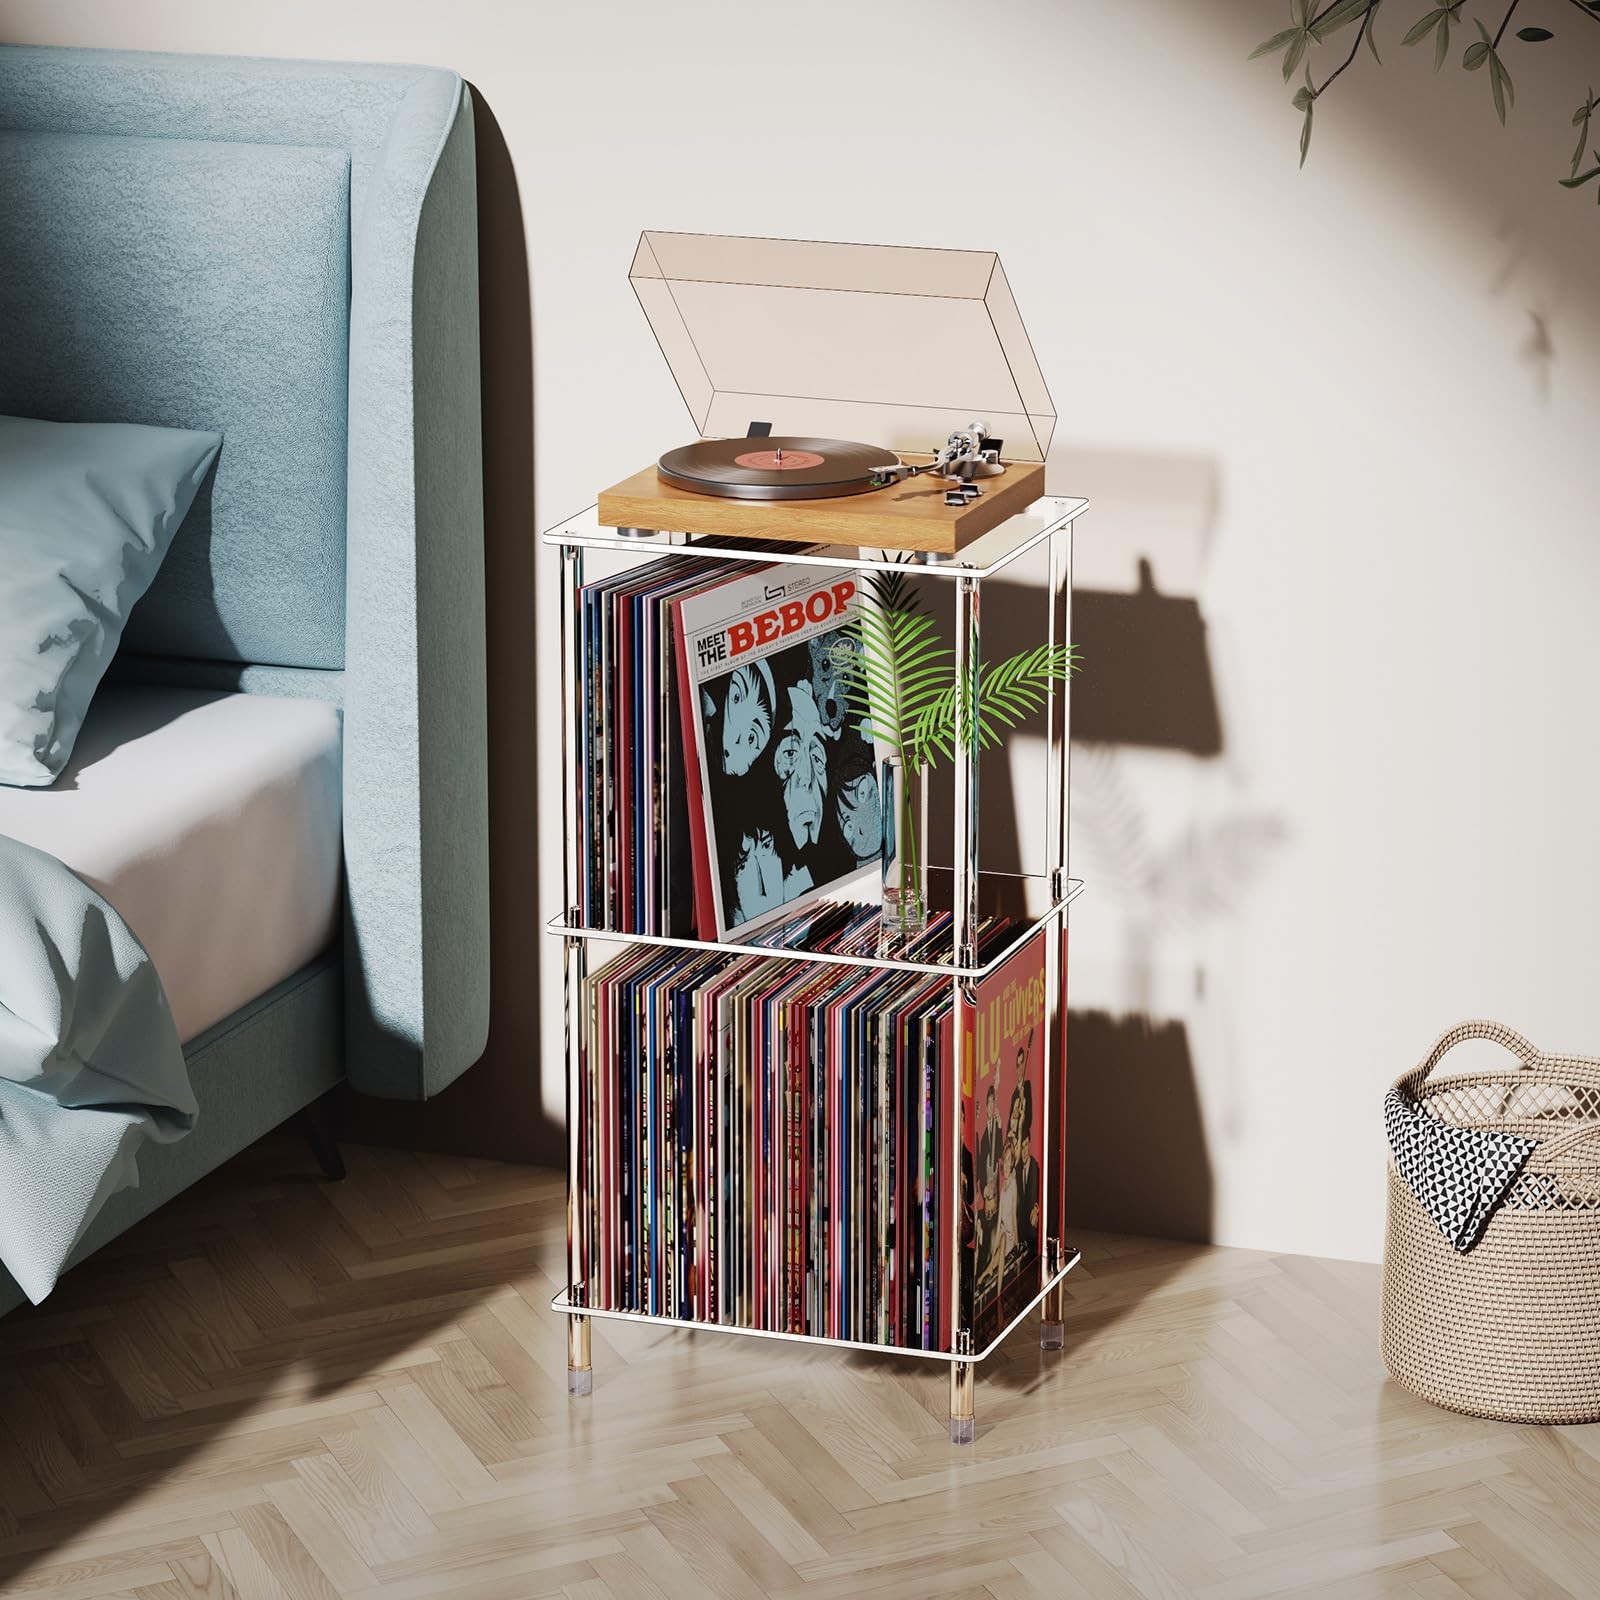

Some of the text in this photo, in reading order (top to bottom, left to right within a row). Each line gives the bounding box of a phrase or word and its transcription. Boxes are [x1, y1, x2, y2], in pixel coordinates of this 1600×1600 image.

[787, 576, 811, 592] STEREO
[698, 581, 856, 667] THE BEBOP
[697, 630, 726, 652] MEET
